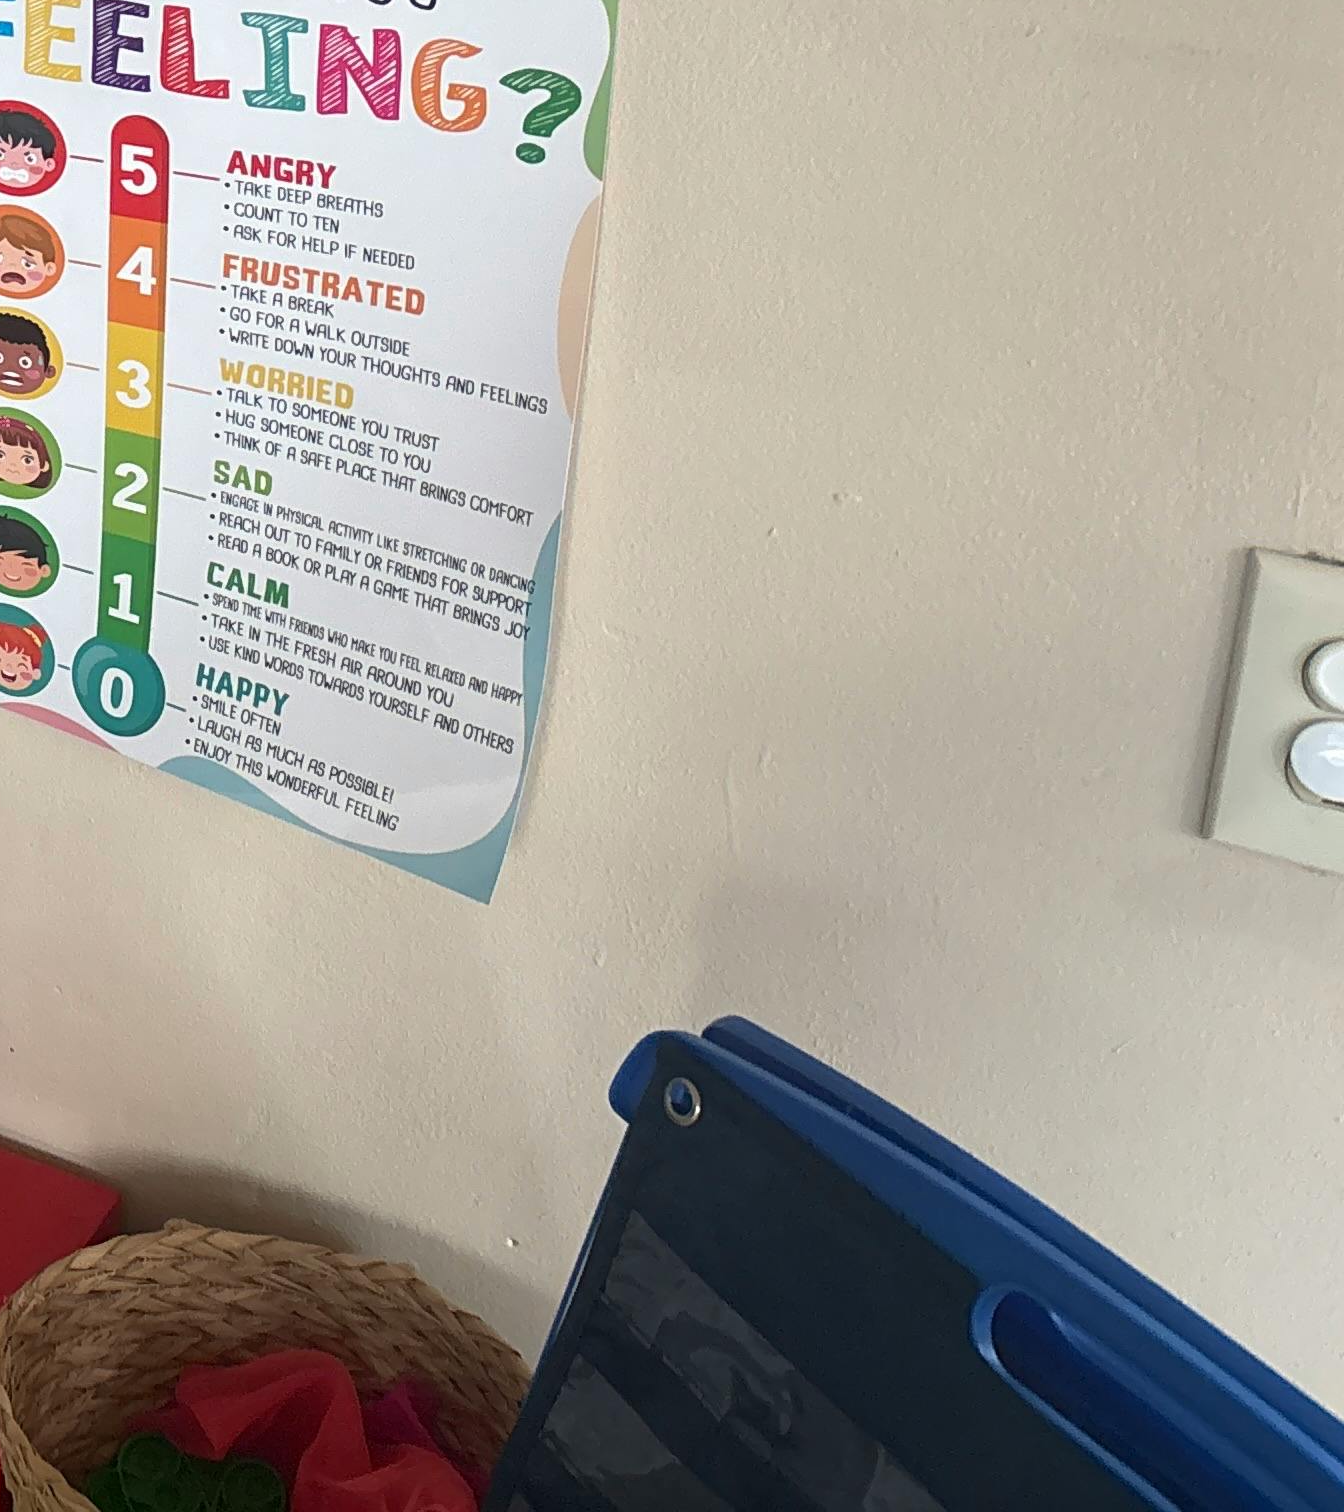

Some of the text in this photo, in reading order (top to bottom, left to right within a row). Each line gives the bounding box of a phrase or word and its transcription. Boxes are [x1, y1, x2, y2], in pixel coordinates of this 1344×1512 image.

[120, 145, 158, 195] 5
[227, 150, 337, 188] ANGRY
[234, 179, 383, 218] TAKE DEEP BREATHS
[234, 202, 339, 235] COUNT TO TEN
[116, 246, 156, 295] 4
[234, 224, 415, 271] ASK FOR HELP IF NEEDED
[223, 255, 425, 315] FRUSTRATED
[231, 285, 334, 319] TAKE A BREAK
[230, 306, 410, 358] GO FOR A WALK OUTSIDE
[115, 360, 152, 409] 3
[219, 358, 354, 409] WORRIED
[229, 327, 548, 415] WRITE DOWN YOUR THOUGHTS AND FEELINGS
[226, 387, 440, 451] TALK TO SOMEONE YOU TRUST
[112, 463, 148, 514] 2
[213, 460, 272, 495] SAD
[207, 562, 290, 608] CALM
[219, 511, 536, 620] REACH OUT TO FAMILY OR FRIENDS FOR SUPPORT
[108, 573, 141, 624] 1
[211, 612, 454, 707] TAKE IN THE FRESH AIR AROUND YOU
[100, 667, 133, 718] 0
[196, 663, 290, 715] HAPPY
[200, 695, 281, 737] SMILE OFTEN
[194, 739, 399, 830] ENJOY THIS WONDERFUL FEELING
[197, 719, 394, 803] LAUGH AS MUCH AS POSSIBLE!
